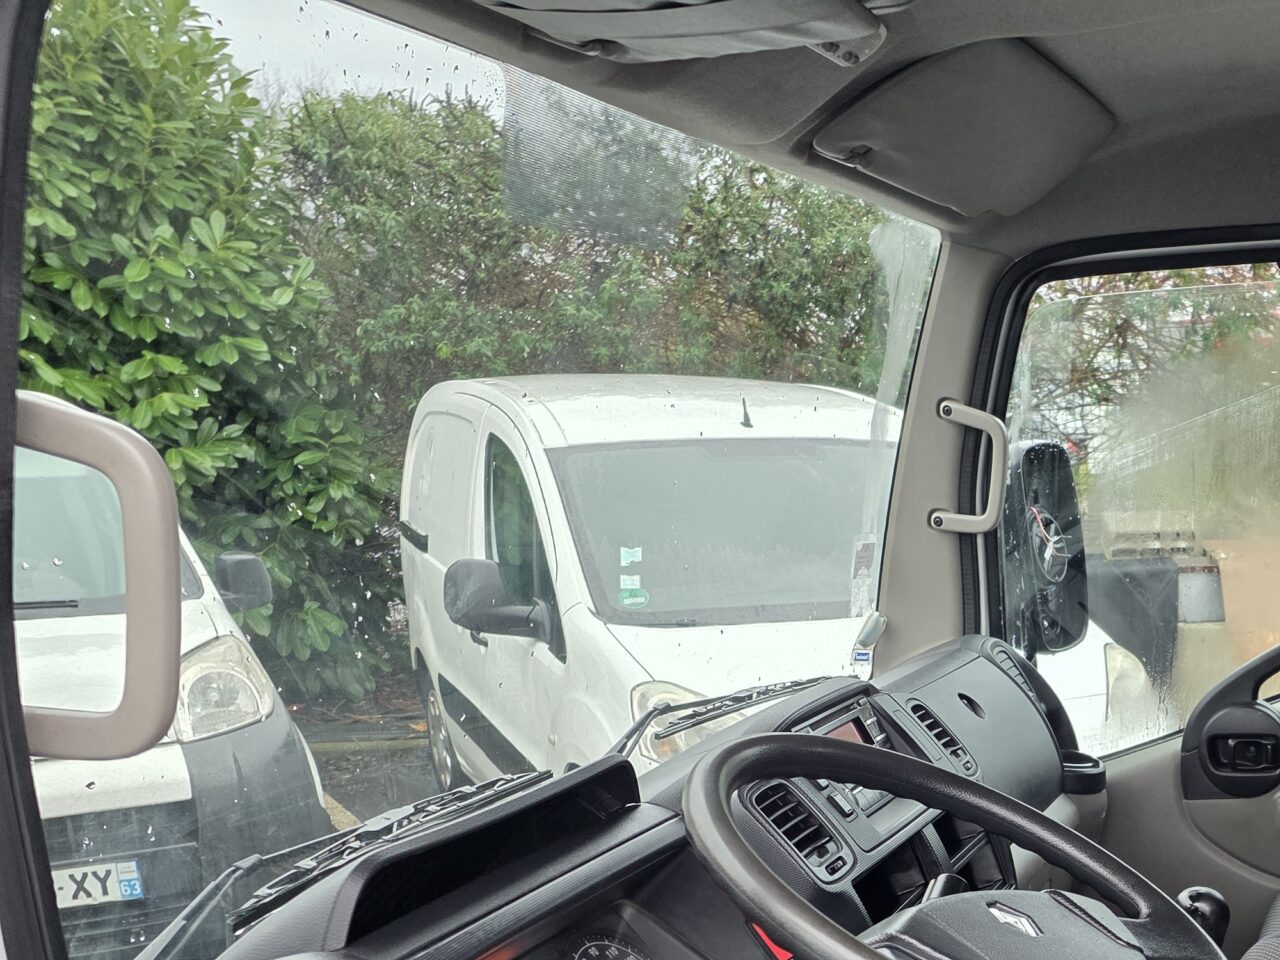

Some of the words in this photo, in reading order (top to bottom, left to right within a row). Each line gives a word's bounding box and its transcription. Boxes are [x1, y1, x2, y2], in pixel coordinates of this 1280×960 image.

[120, 879, 141, 896] 63
[588, 946, 600, 958] 90
[605, 946, 619, 959] 110
